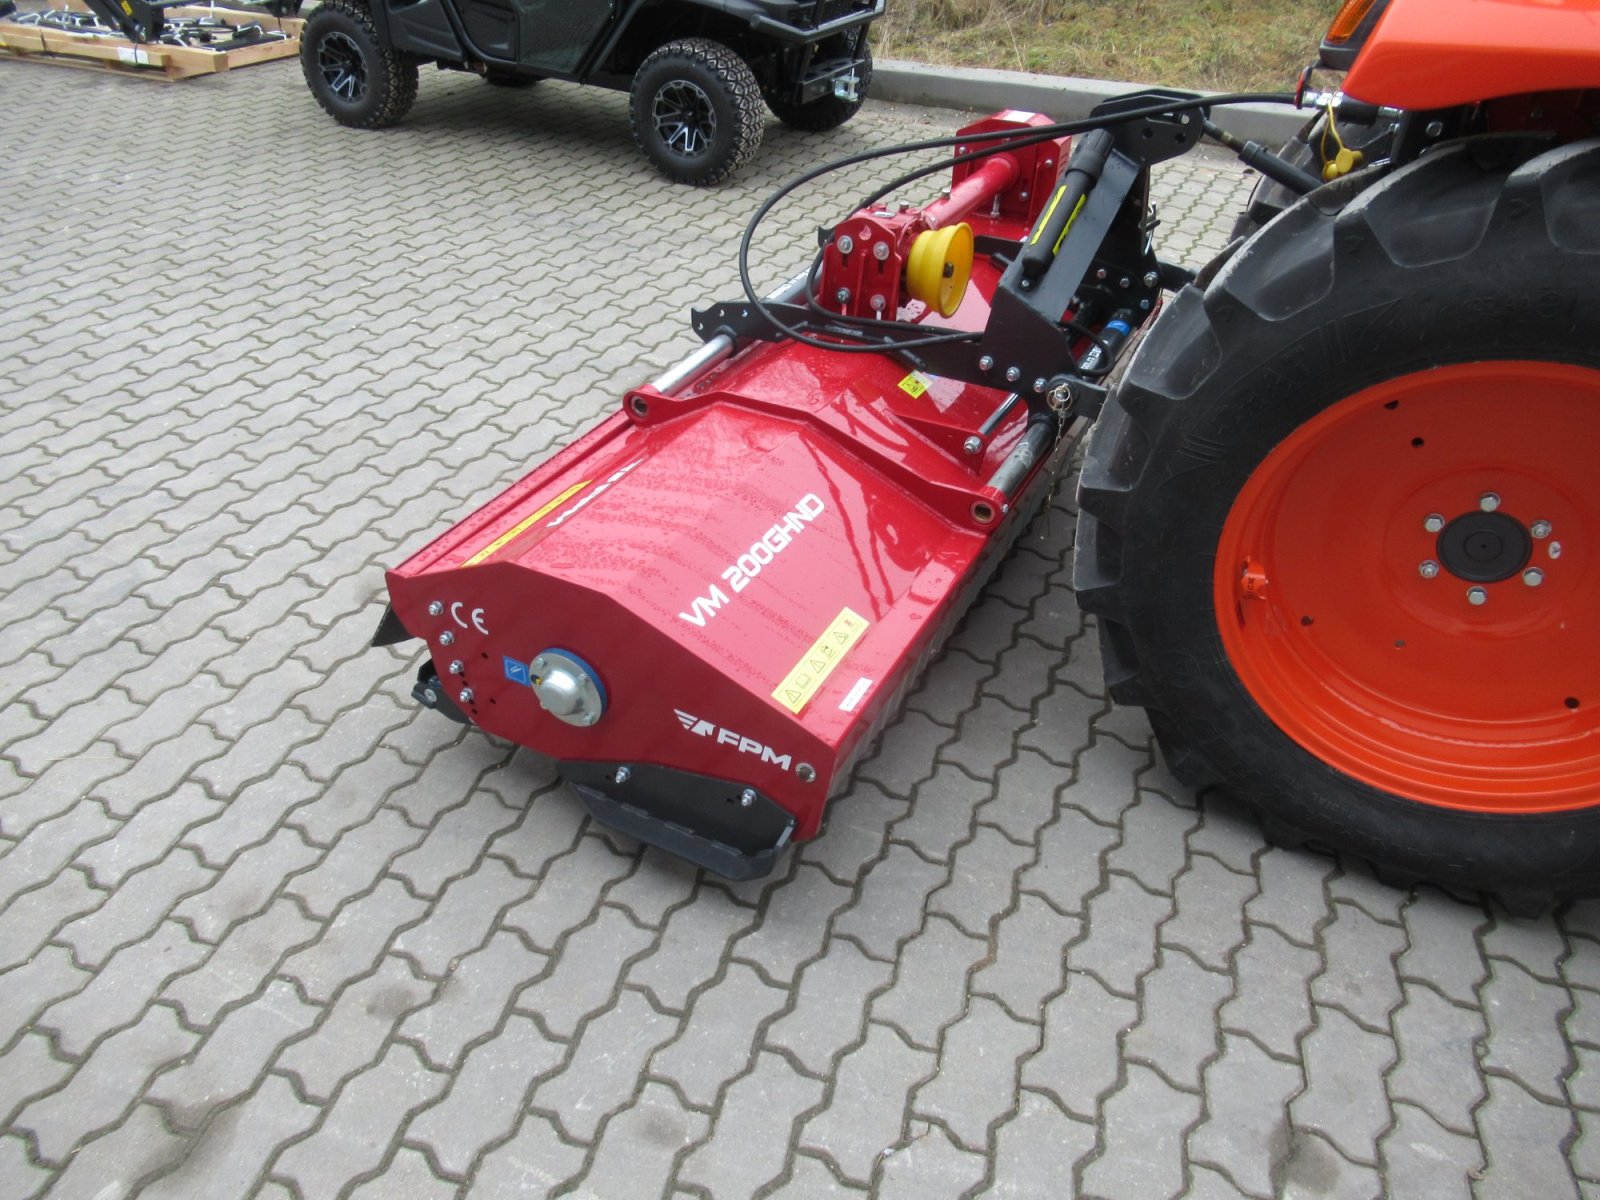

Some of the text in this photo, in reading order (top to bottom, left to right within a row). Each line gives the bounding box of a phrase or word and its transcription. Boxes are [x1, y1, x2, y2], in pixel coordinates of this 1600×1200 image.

[678, 583, 730, 627] VM
[720, 492, 825, 593] 200GHND
[450, 600, 490, 636] CE
[716, 727, 792, 771] FPM
